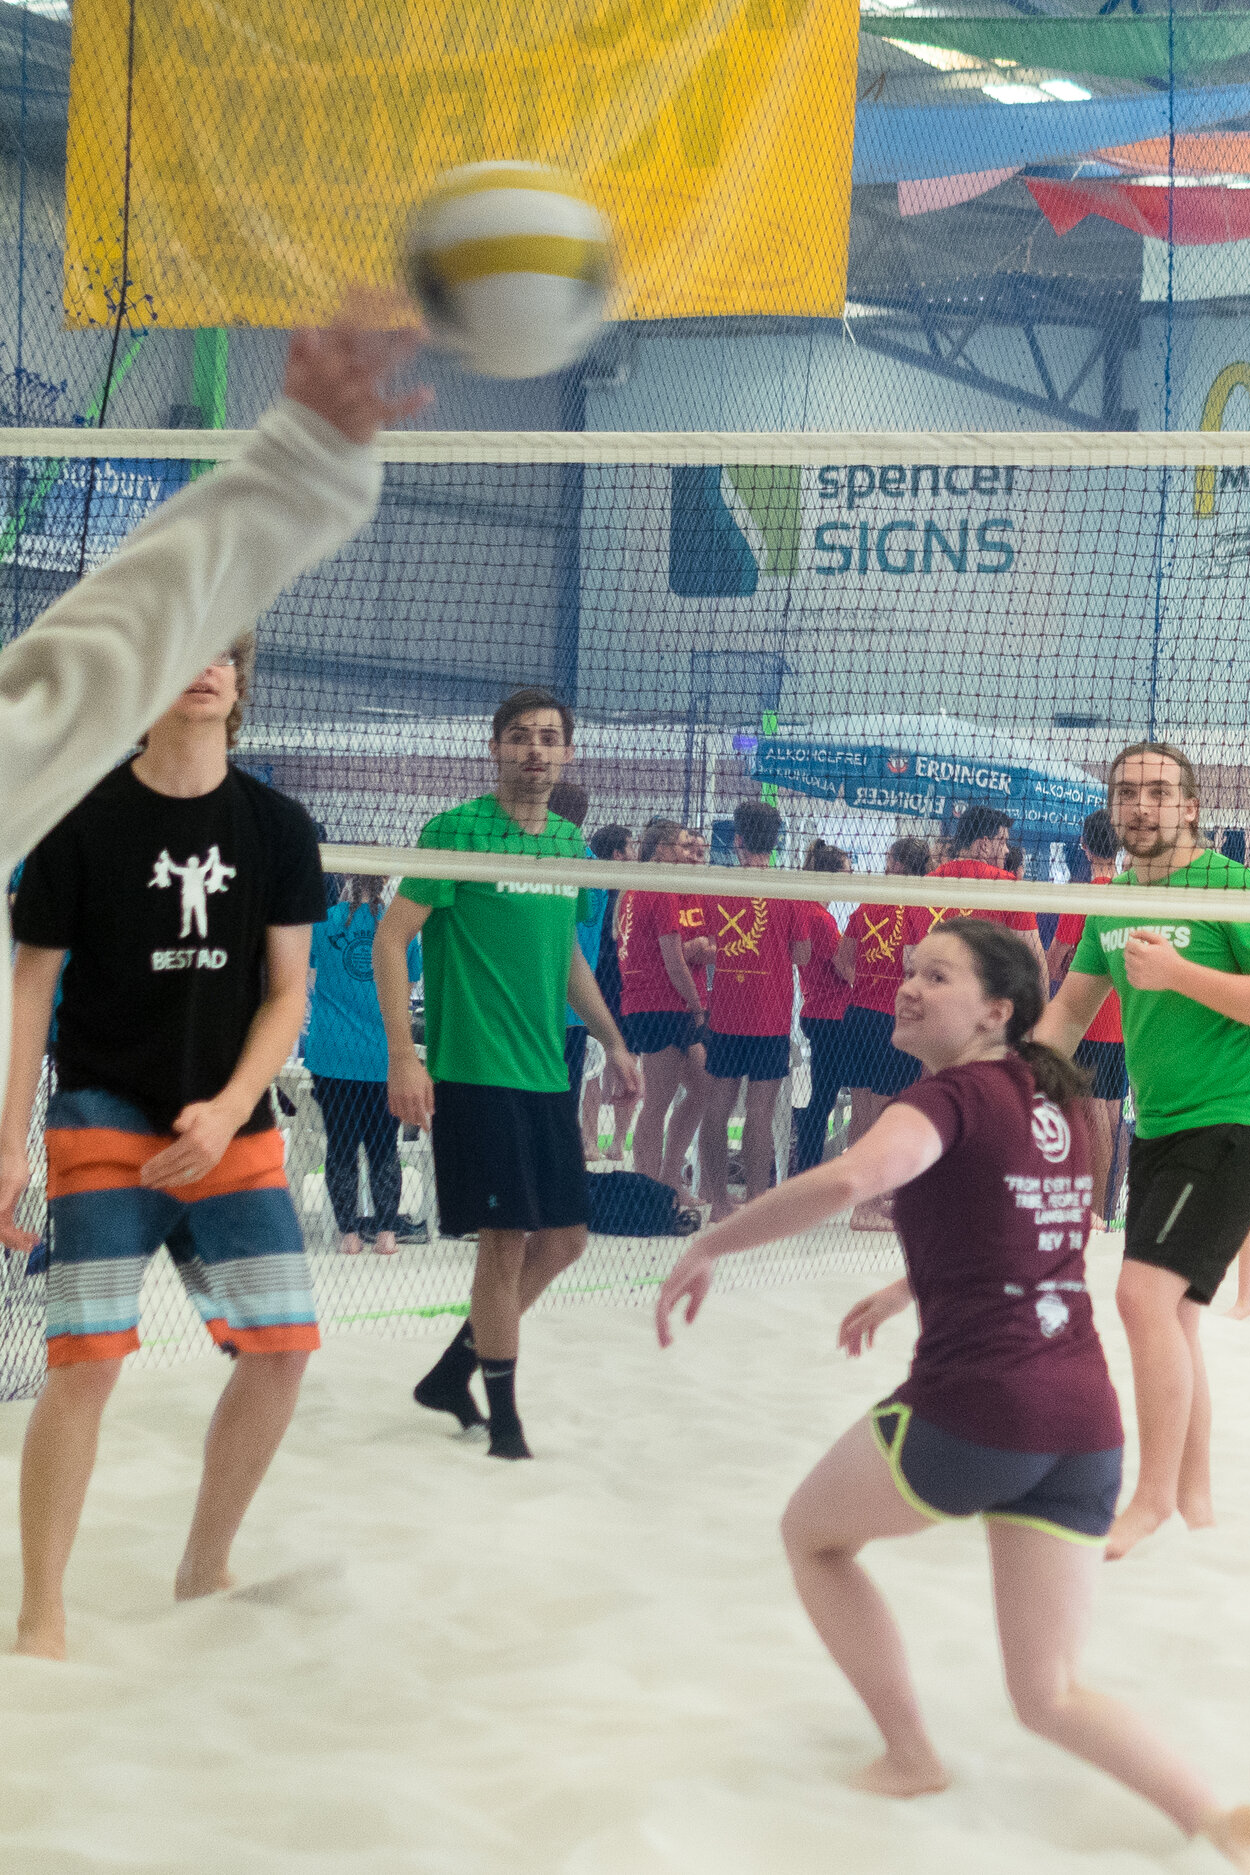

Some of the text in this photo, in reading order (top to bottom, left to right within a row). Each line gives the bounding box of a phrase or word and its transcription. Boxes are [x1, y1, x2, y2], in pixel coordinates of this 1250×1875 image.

[817, 465, 1017, 510] spencer
[814, 518, 1015, 577] SIGNS
[914, 755, 1014, 795] ERDINGER
[151, 948, 228, 970] BEST AD
